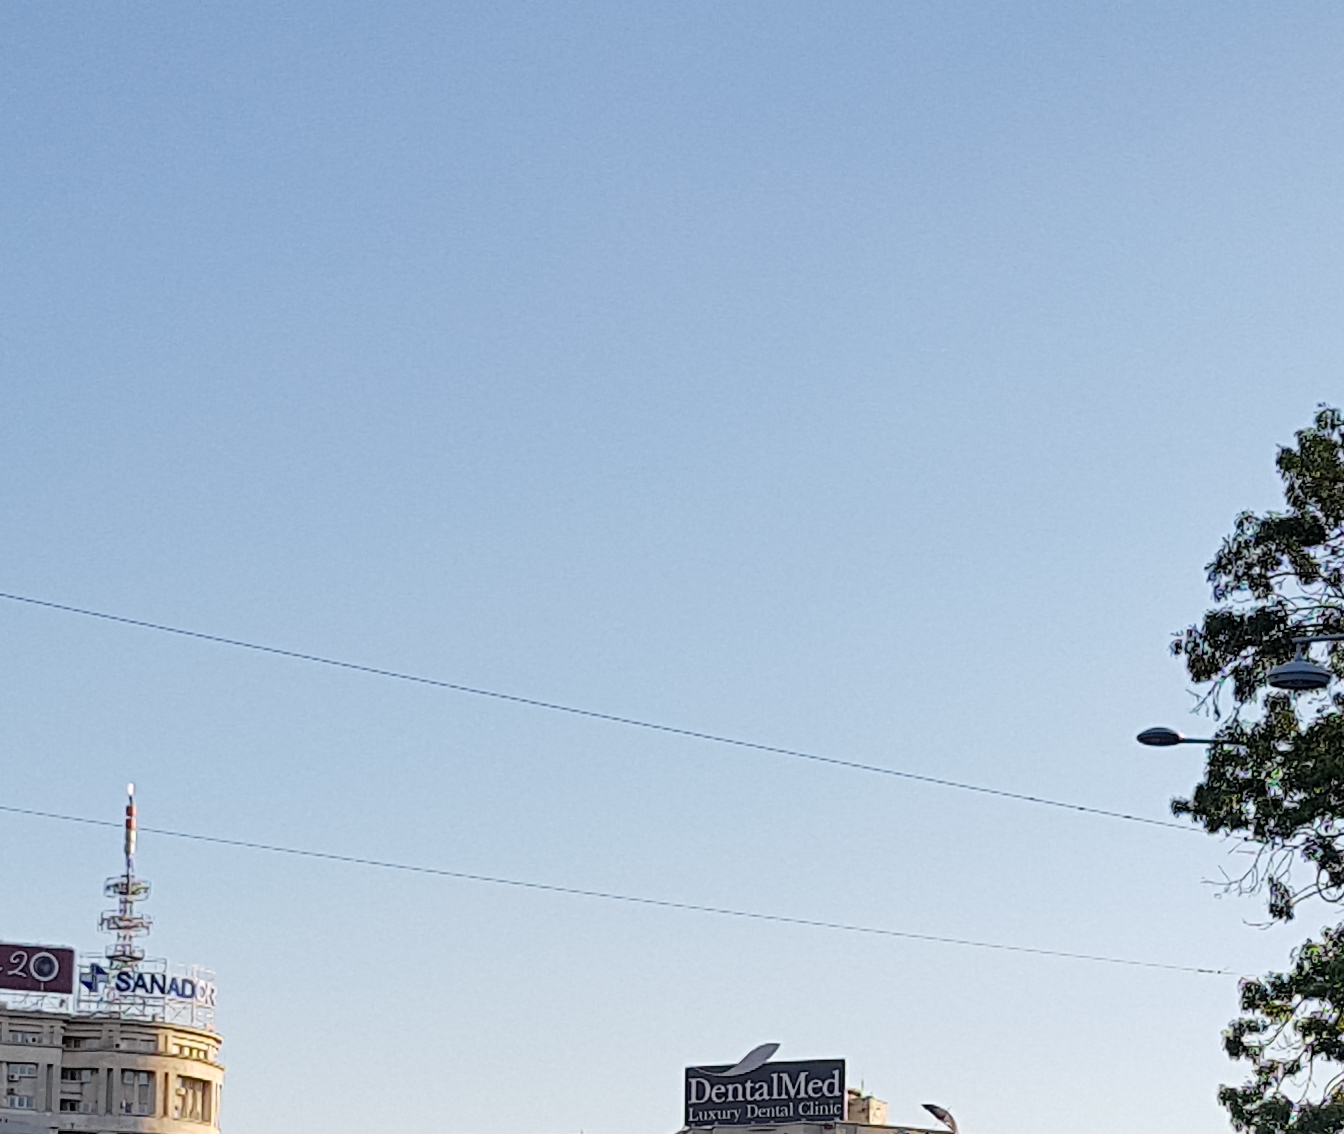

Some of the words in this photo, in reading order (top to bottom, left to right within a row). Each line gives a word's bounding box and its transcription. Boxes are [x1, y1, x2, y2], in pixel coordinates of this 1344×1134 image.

[115, 971, 217, 1006] SANADOR
[688, 1069, 841, 1104] DentalMed
[688, 1107, 742, 1123] Luxury
[745, 1104, 794, 1119] Dental
[798, 1101, 841, 1117] Clinic
